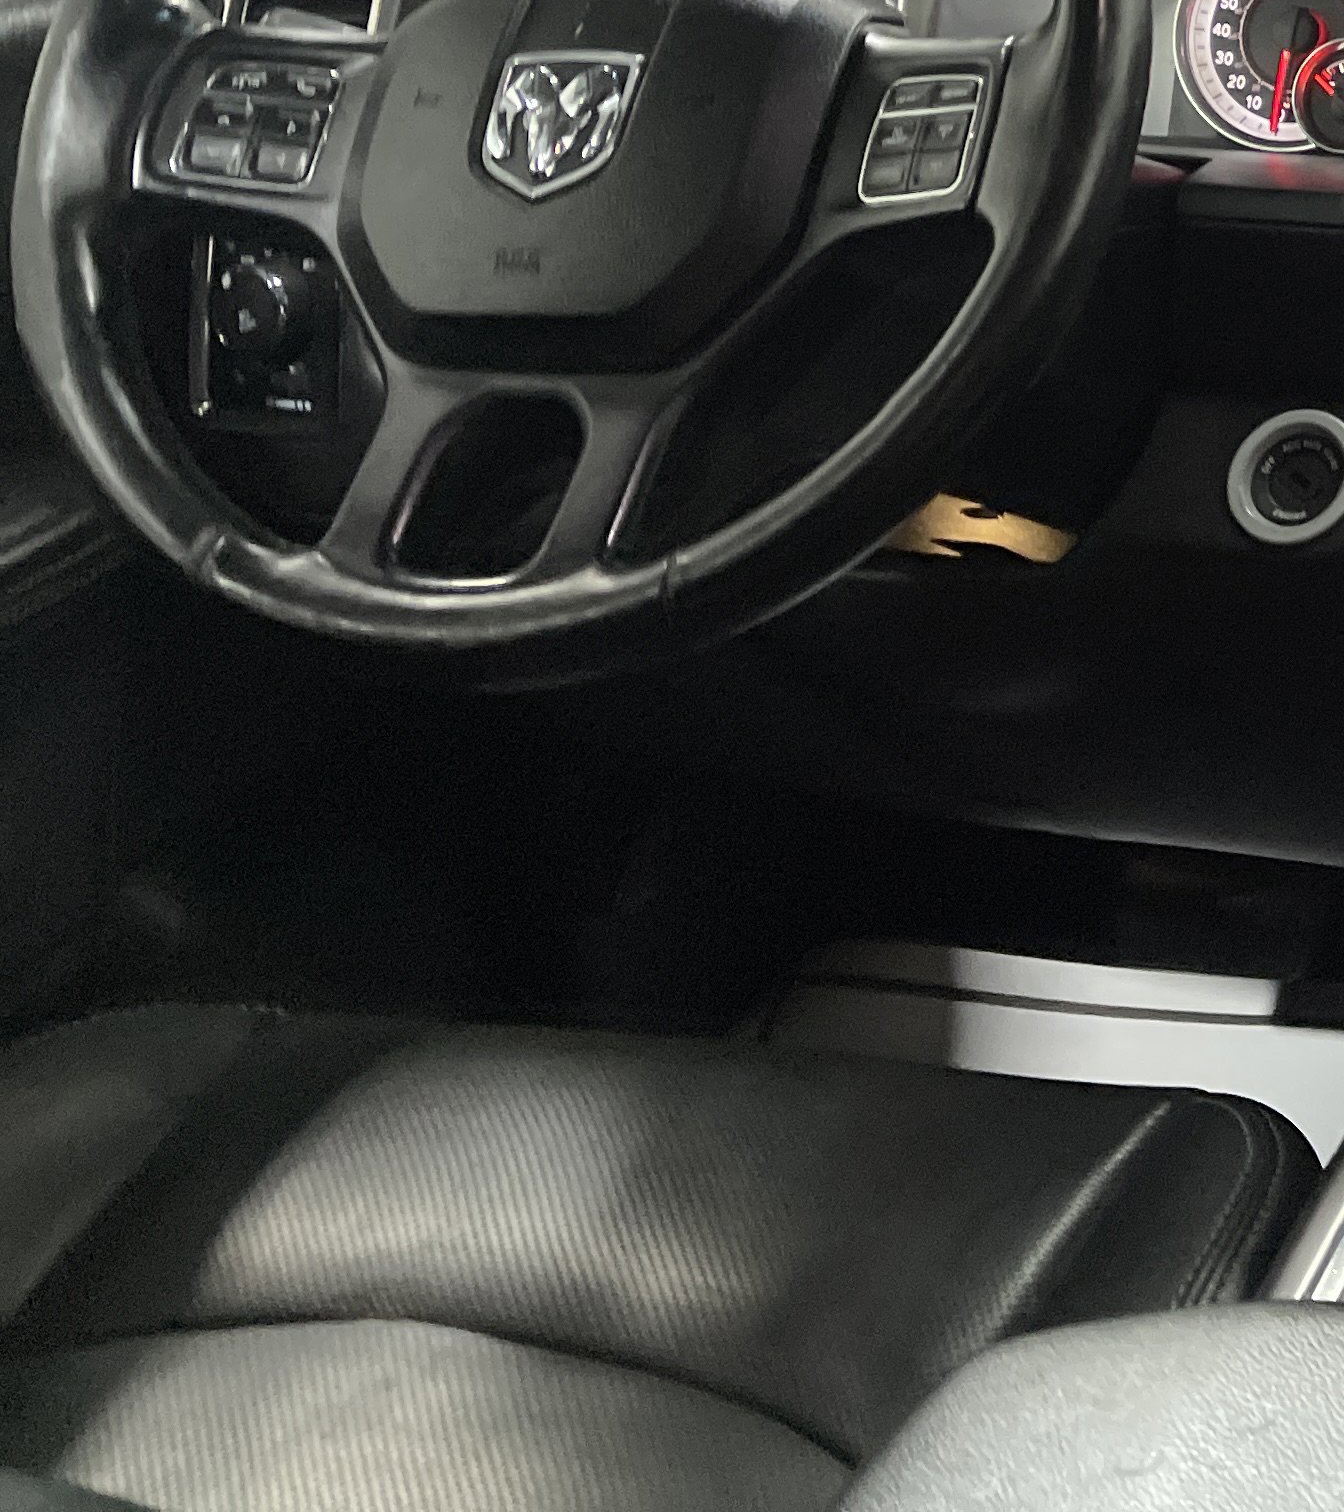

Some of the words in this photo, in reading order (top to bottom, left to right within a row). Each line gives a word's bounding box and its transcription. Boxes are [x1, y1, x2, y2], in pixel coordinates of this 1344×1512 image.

[1212, 22, 1232, 38] 40
[1214, 50, 1234, 66] 30
[1226, 74, 1247, 90] 20
[1245, 94, 1263, 111] 10
